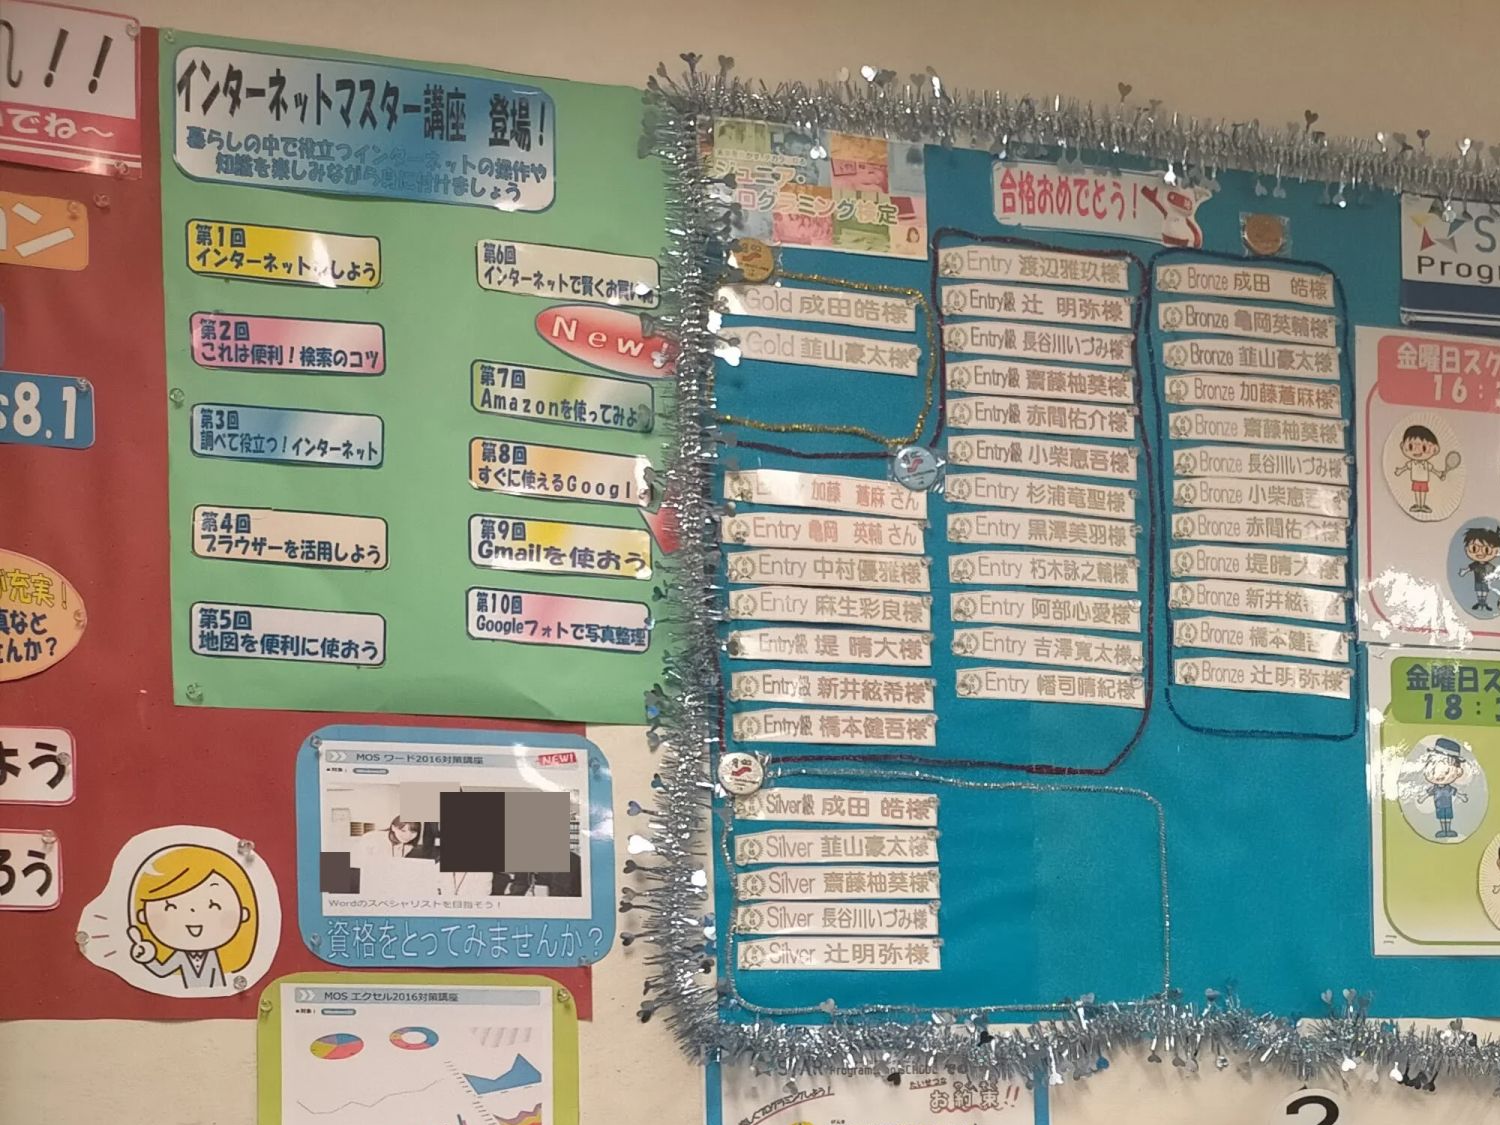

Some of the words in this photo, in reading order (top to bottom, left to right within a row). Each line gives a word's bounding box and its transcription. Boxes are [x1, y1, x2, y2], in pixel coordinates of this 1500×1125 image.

[176, 59, 467, 143] インターネットマスター講座
[1000, 167, 1139, 222] 合格おめでとう!
[195, 224, 246, 248] 第1回
[483, 242, 517, 265] 第6回
[967, 250, 1012, 274] Entry
[196, 250, 376, 283] インターネットしよう
[1187, 266, 1228, 291] Bronze
[1185, 305, 1229, 330] Bronze
[200, 319, 249, 342] 第2回
[1190, 343, 1234, 367] Bronze
[480, 364, 526, 389] 第7回
[1194, 377, 1235, 402] Bronze
[200, 408, 240, 431] 第3回
[1195, 412, 1238, 437] Bronze
[481, 442, 528, 465] 第8回
[1199, 450, 1243, 474] Bronze
[974, 477, 1020, 502] Entry
[1200, 481, 1243, 504] Bronze
[201, 511, 252, 535] 第4回
[480, 518, 527, 540] 第9回
[752, 516, 801, 542] Entry
[888, 524, 917, 547] さん
[975, 515, 1021, 540] Entry
[1198, 514, 1241, 538] Bronze
[201, 534, 381, 566] ブラウザーを活用しよう
[478, 540, 647, 572] Gmailを使おう
[1196, 549, 1240, 574] Bronze
[758, 554, 807, 579] Entry
[978, 556, 1023, 579] Entry
[476, 591, 523, 615] 第10回
[760, 591, 808, 615] Entry
[980, 594, 1025, 619] Entry
[1196, 584, 1240, 608] Bronze
[198, 608, 252, 632] 第5回
[476, 614, 647, 647] Googleフォトで写真整理
[982, 631, 1027, 656] Entry
[1200, 621, 1244, 646] Bronze
[198, 631, 379, 662] 地図を便利に使おう
[985, 671, 1030, 694] Entry
[1201, 661, 1245, 684] Bronze
[356, 752, 381, 762] MOS
[821, 795, 870, 818] 成田
[766, 834, 813, 858] Silver
[768, 871, 816, 895] Silver
[766, 906, 814, 929] Silver
[327, 919, 604, 960] 資格をとってみませんか?
[768, 941, 816, 965] Silver
[324, 991, 348, 1002] MOS
